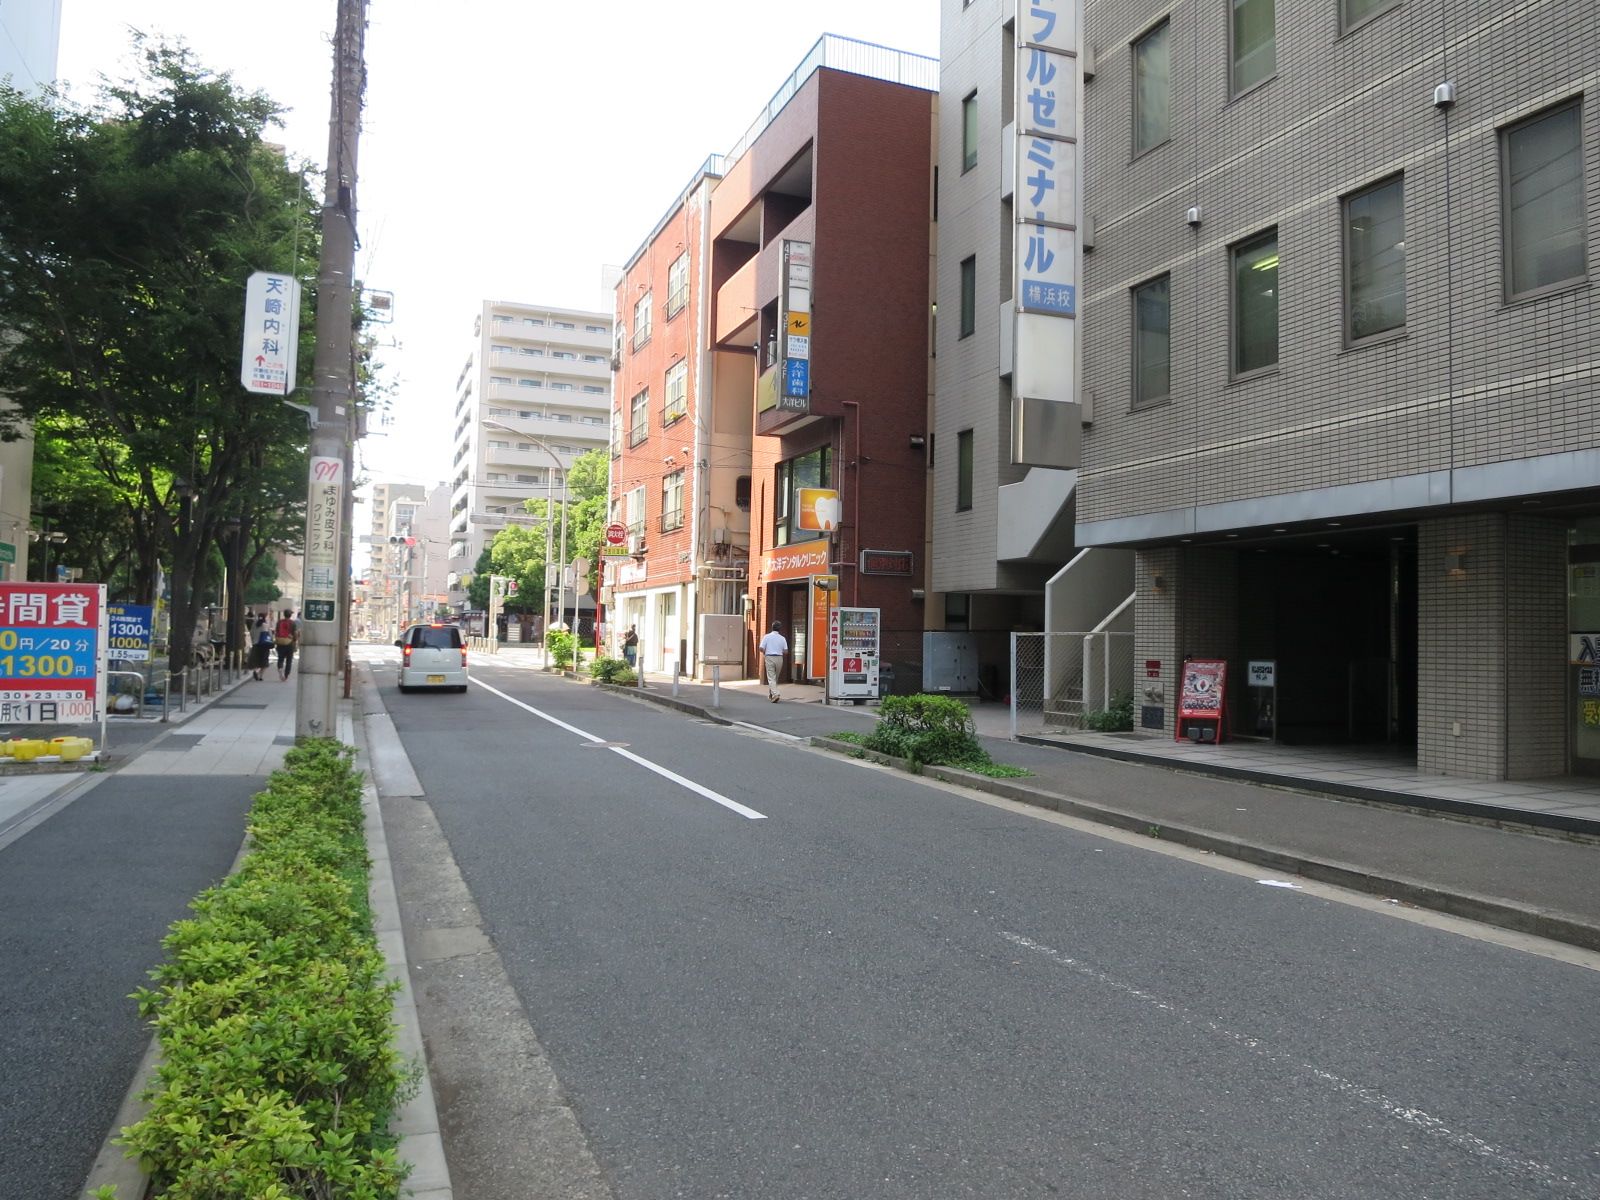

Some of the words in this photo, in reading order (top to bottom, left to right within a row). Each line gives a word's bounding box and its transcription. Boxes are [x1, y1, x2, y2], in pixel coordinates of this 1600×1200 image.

[1025, 0, 1057, 274] フルゼミナール
[1029, 285, 1070, 307] 横浜校
[312, 504, 322, 551] クリニック
